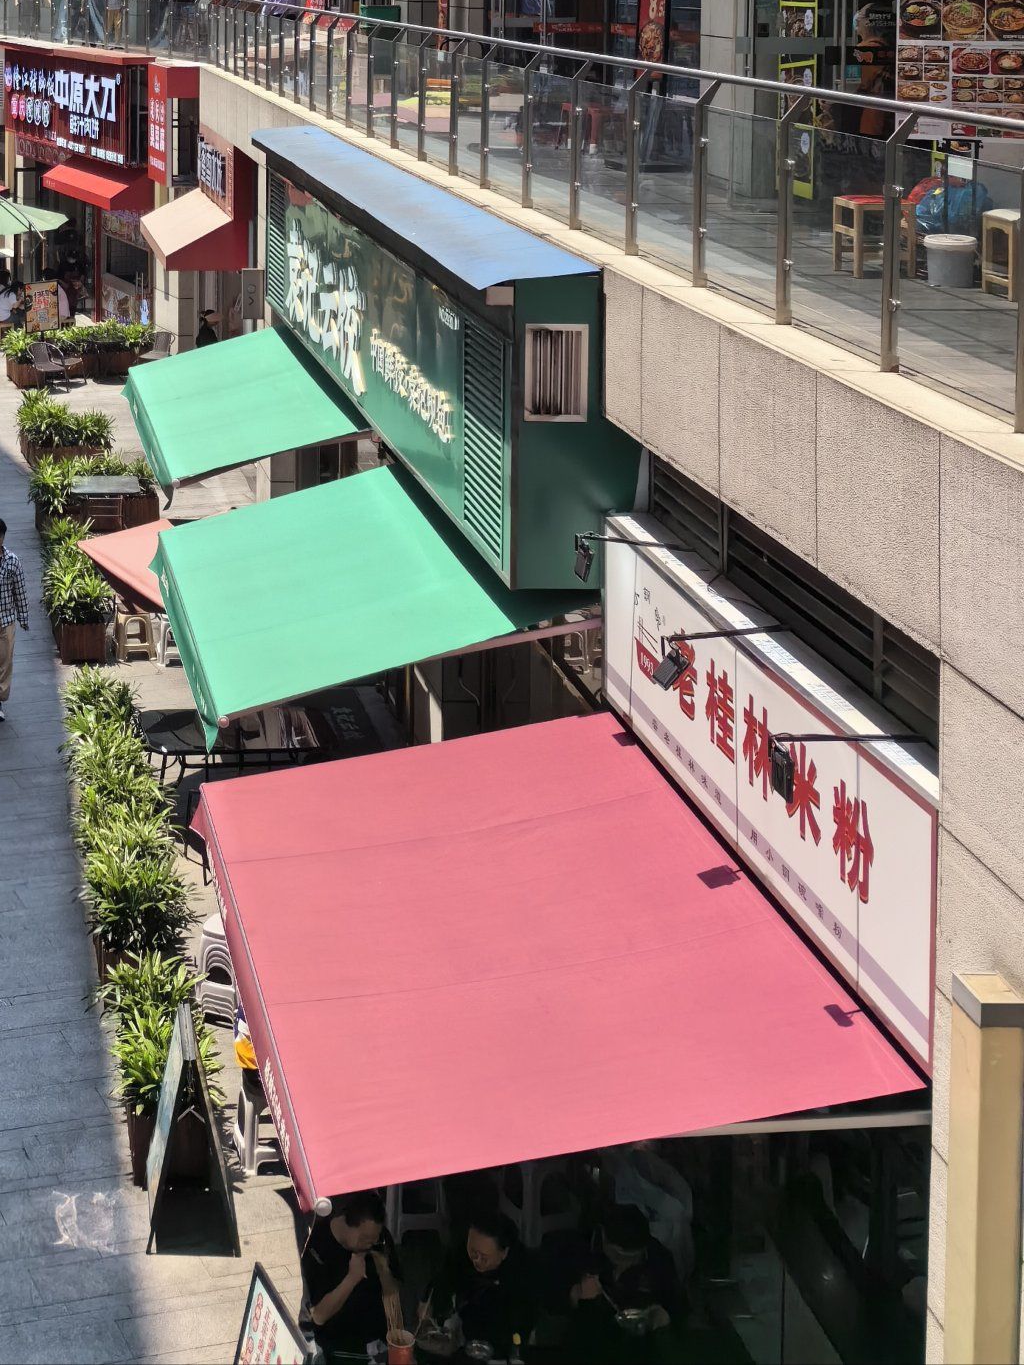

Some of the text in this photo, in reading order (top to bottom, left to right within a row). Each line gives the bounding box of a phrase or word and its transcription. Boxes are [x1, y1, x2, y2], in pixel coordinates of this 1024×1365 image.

[54, 69, 116, 122] 中原大刀
[639, 651, 655, 677] 1993
[672, 626, 876, 904] 老桂林米粉
